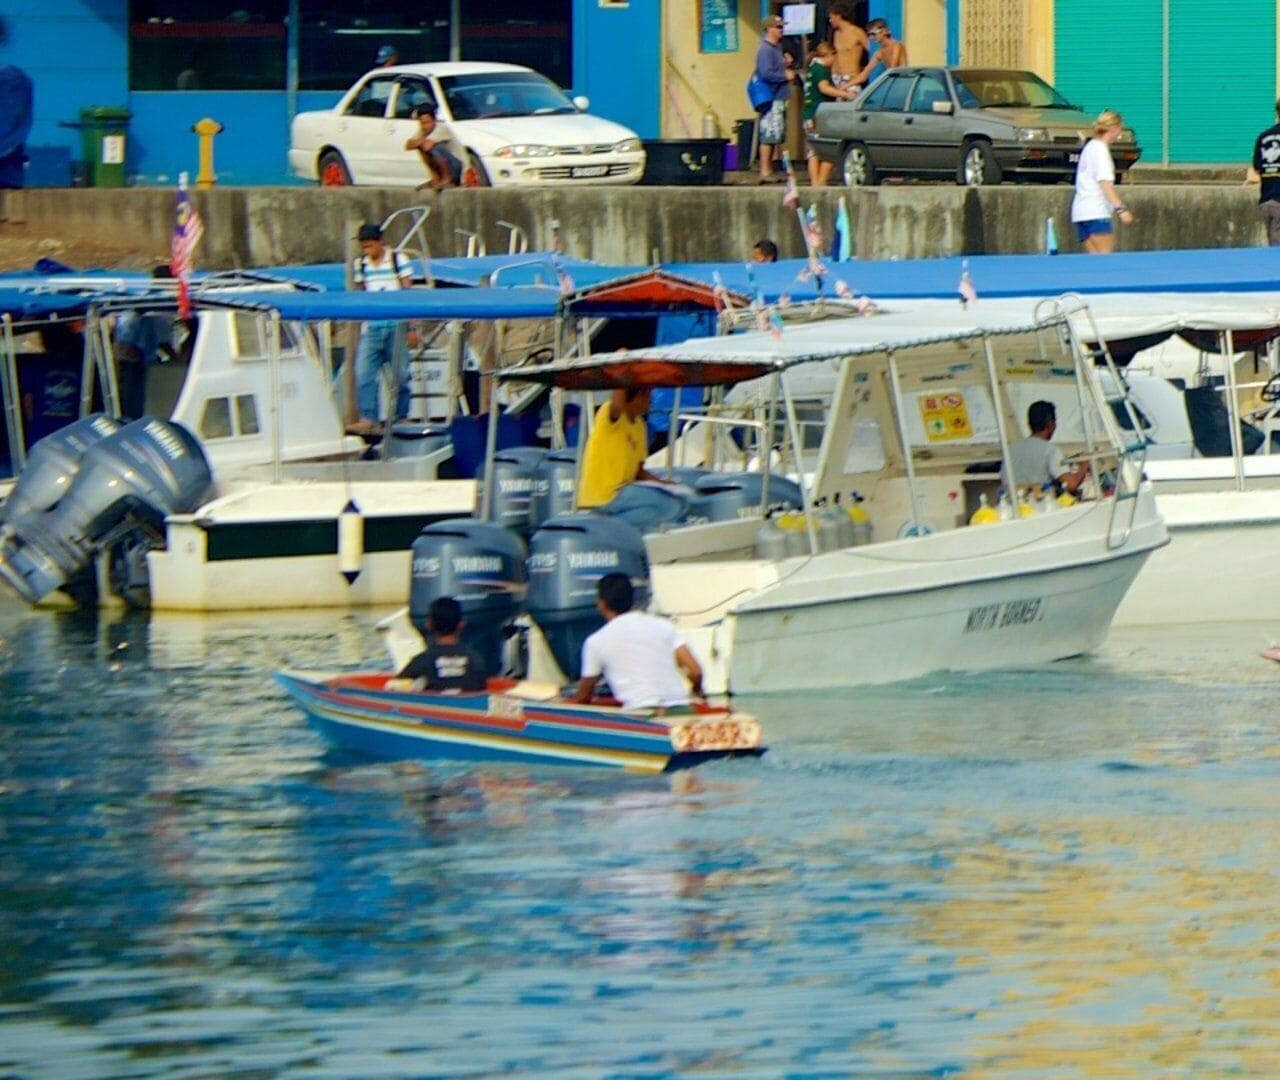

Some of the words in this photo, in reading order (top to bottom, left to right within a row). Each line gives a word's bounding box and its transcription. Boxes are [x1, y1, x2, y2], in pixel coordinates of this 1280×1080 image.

[142, 420, 185, 461] YAMAHA
[452, 556, 503, 573] YAMAHA
[567, 552, 619, 568] YAMAHA
